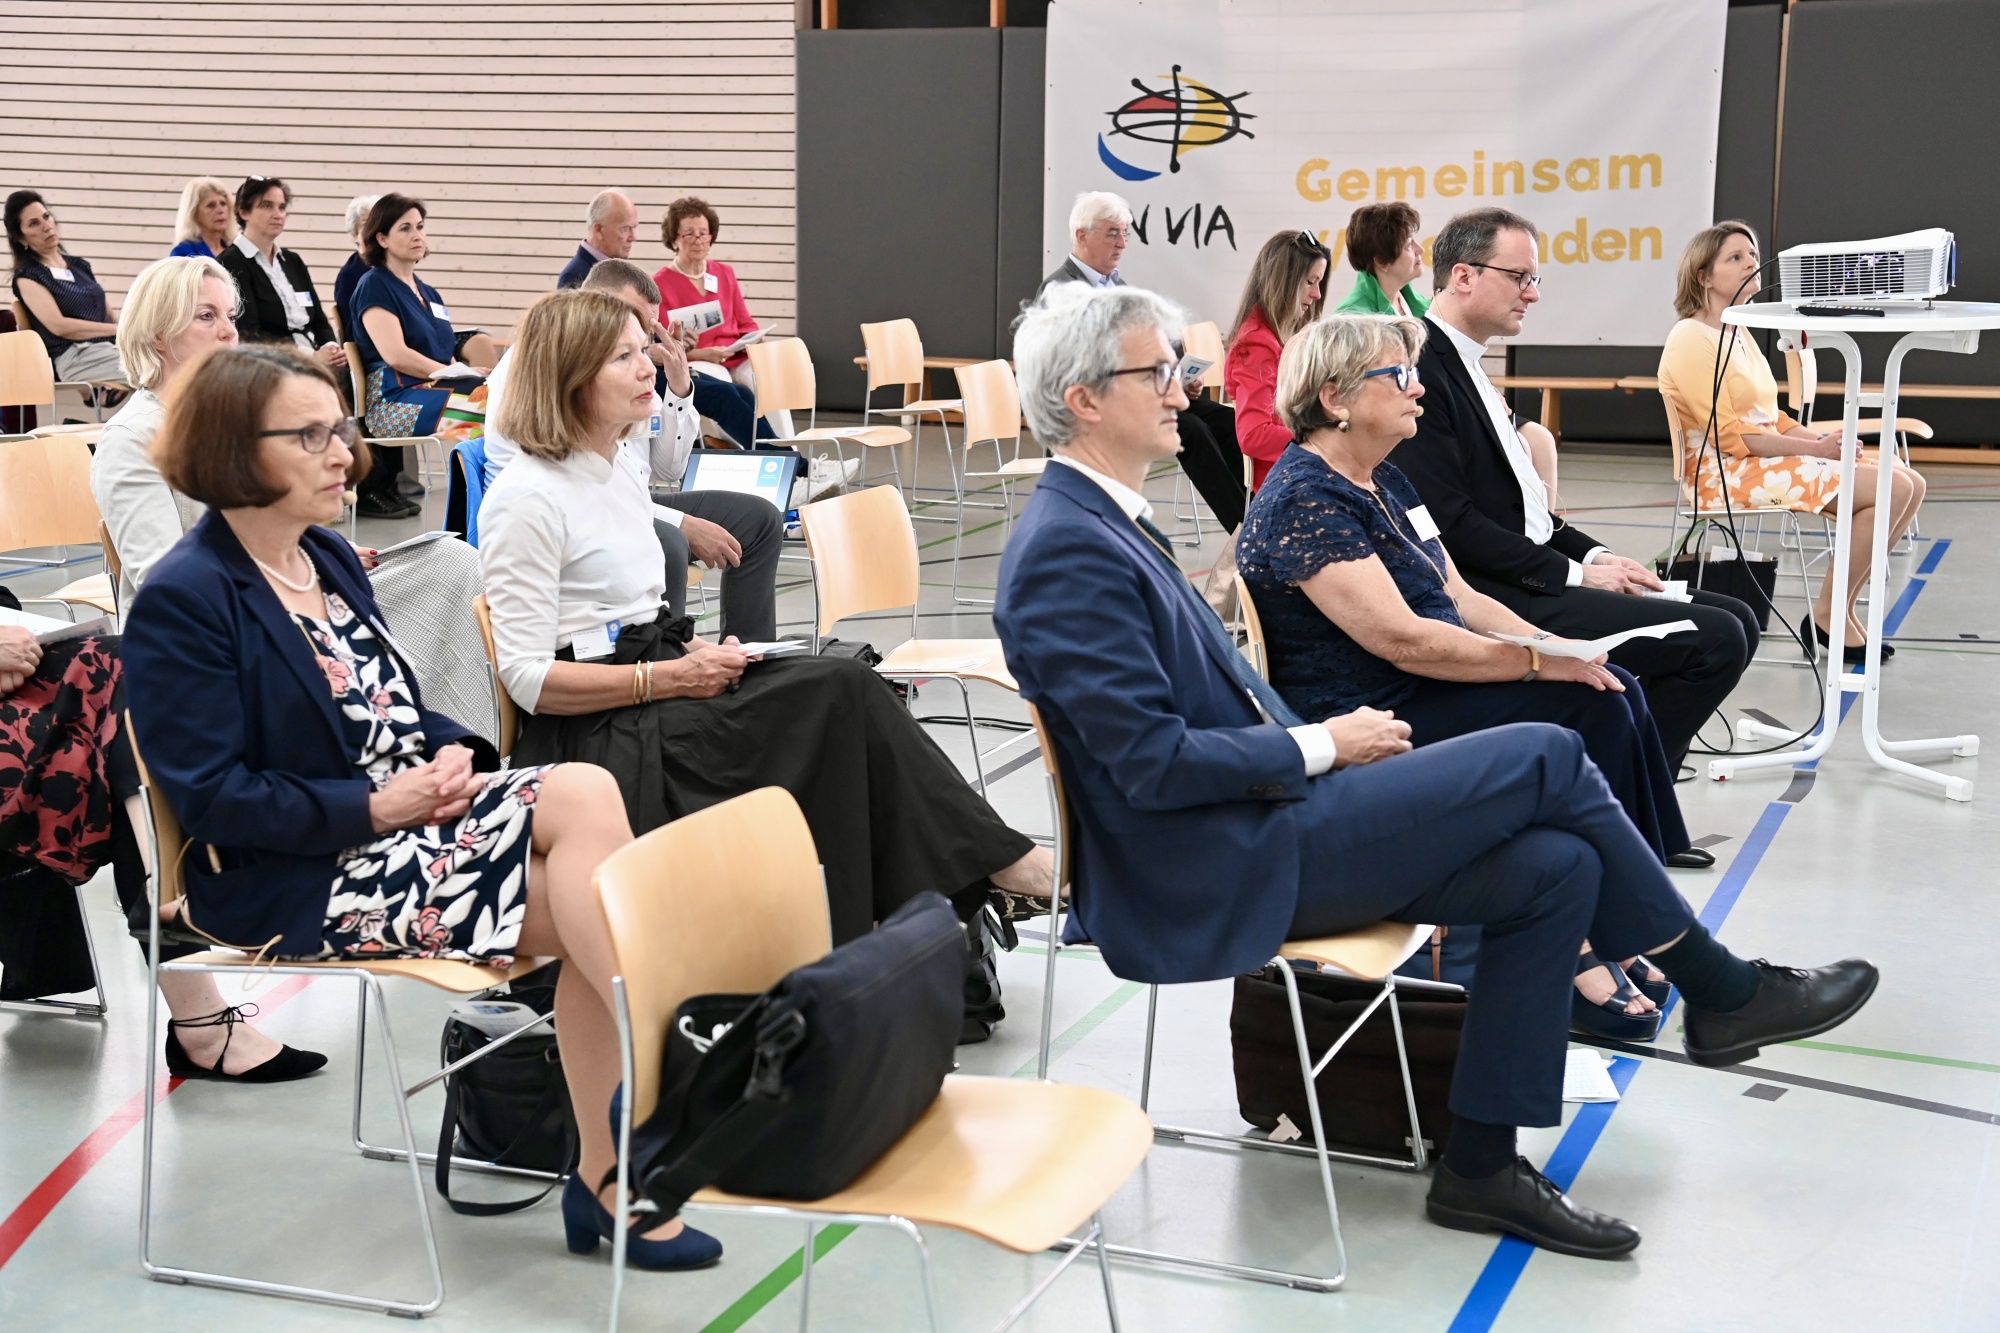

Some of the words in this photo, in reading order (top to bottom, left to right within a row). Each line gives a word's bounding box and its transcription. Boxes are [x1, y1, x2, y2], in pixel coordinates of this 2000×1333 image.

[1296, 150, 1663, 202] Gemeinsam
[1130, 203, 1150, 246] N
[1165, 203, 1237, 252] VIA
